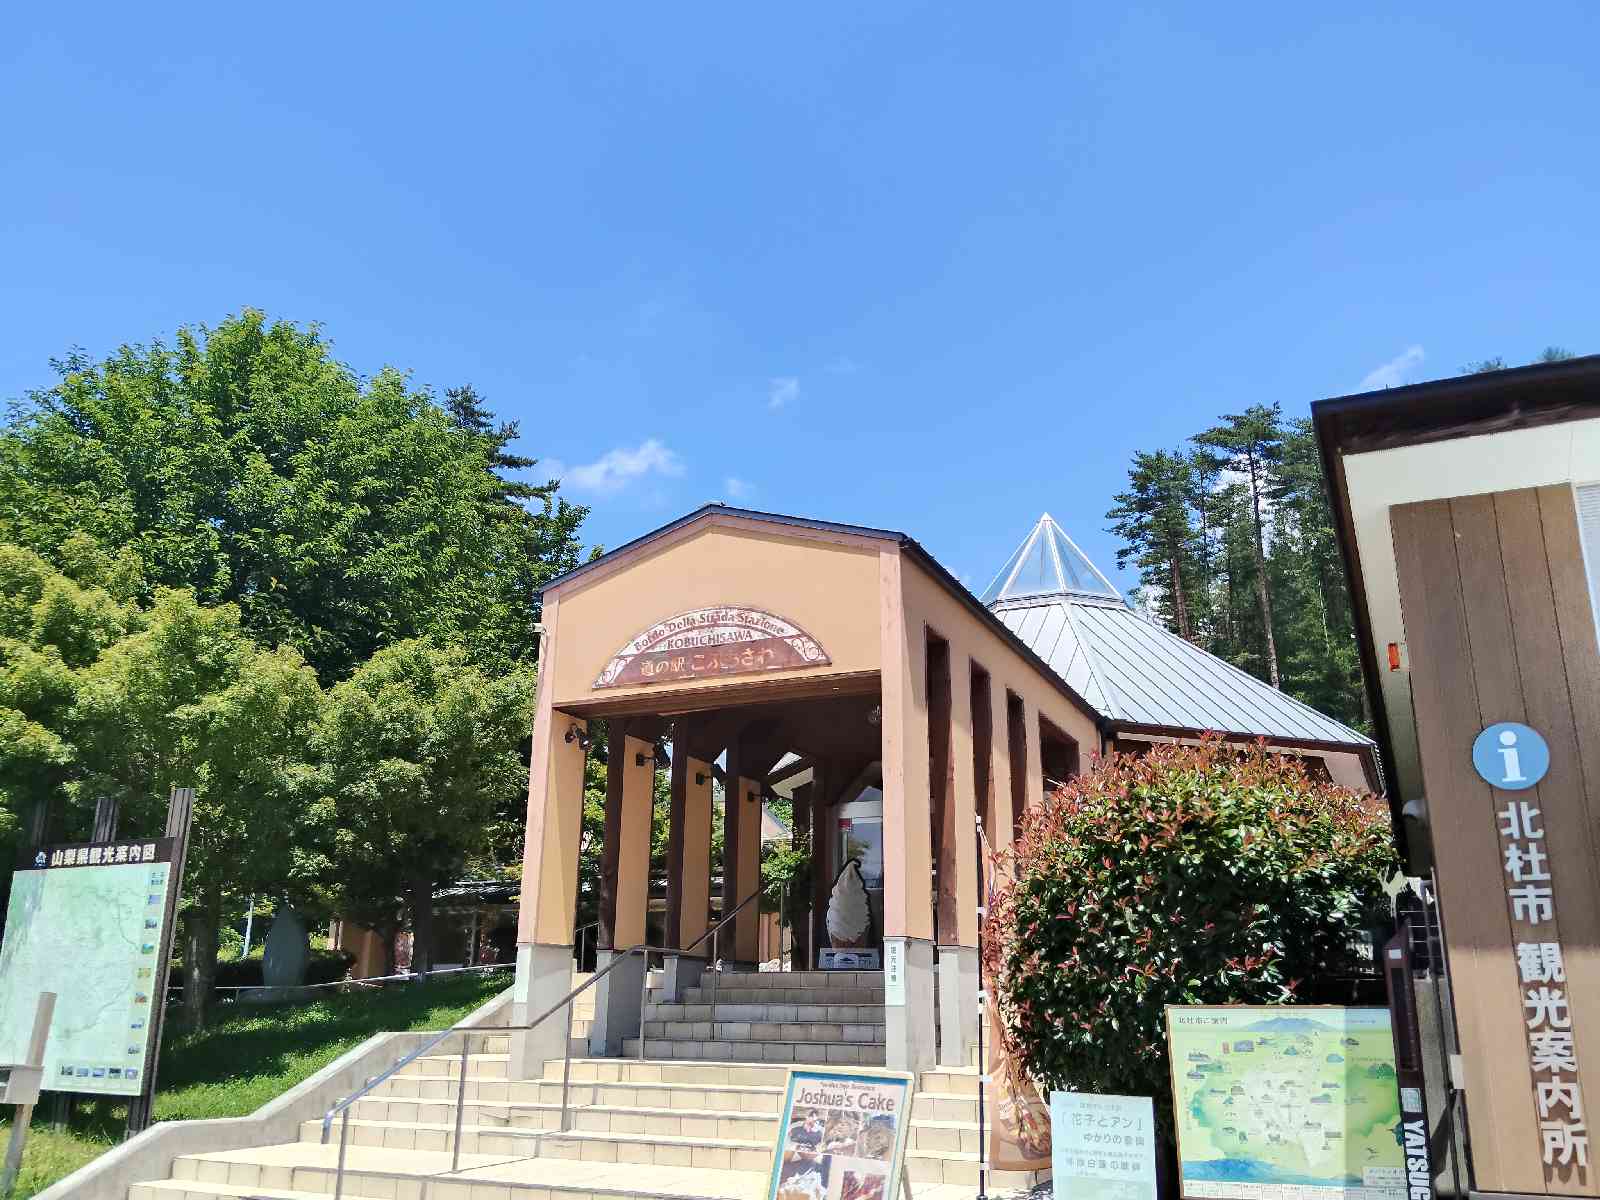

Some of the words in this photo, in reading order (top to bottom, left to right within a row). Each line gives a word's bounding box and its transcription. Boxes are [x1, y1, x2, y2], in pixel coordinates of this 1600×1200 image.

[668, 617, 697, 633] Della
[665, 630, 753, 650] KOBUCHISAWA
[51, 843, 156, 866] 山梨県観光案内図
[1498, 801, 1553, 925] 北杜市
[1517, 941, 1589, 1168] 観光案内所
[796, 1087, 853, 1107] Joshua's
[857, 1092, 895, 1111] Cake
